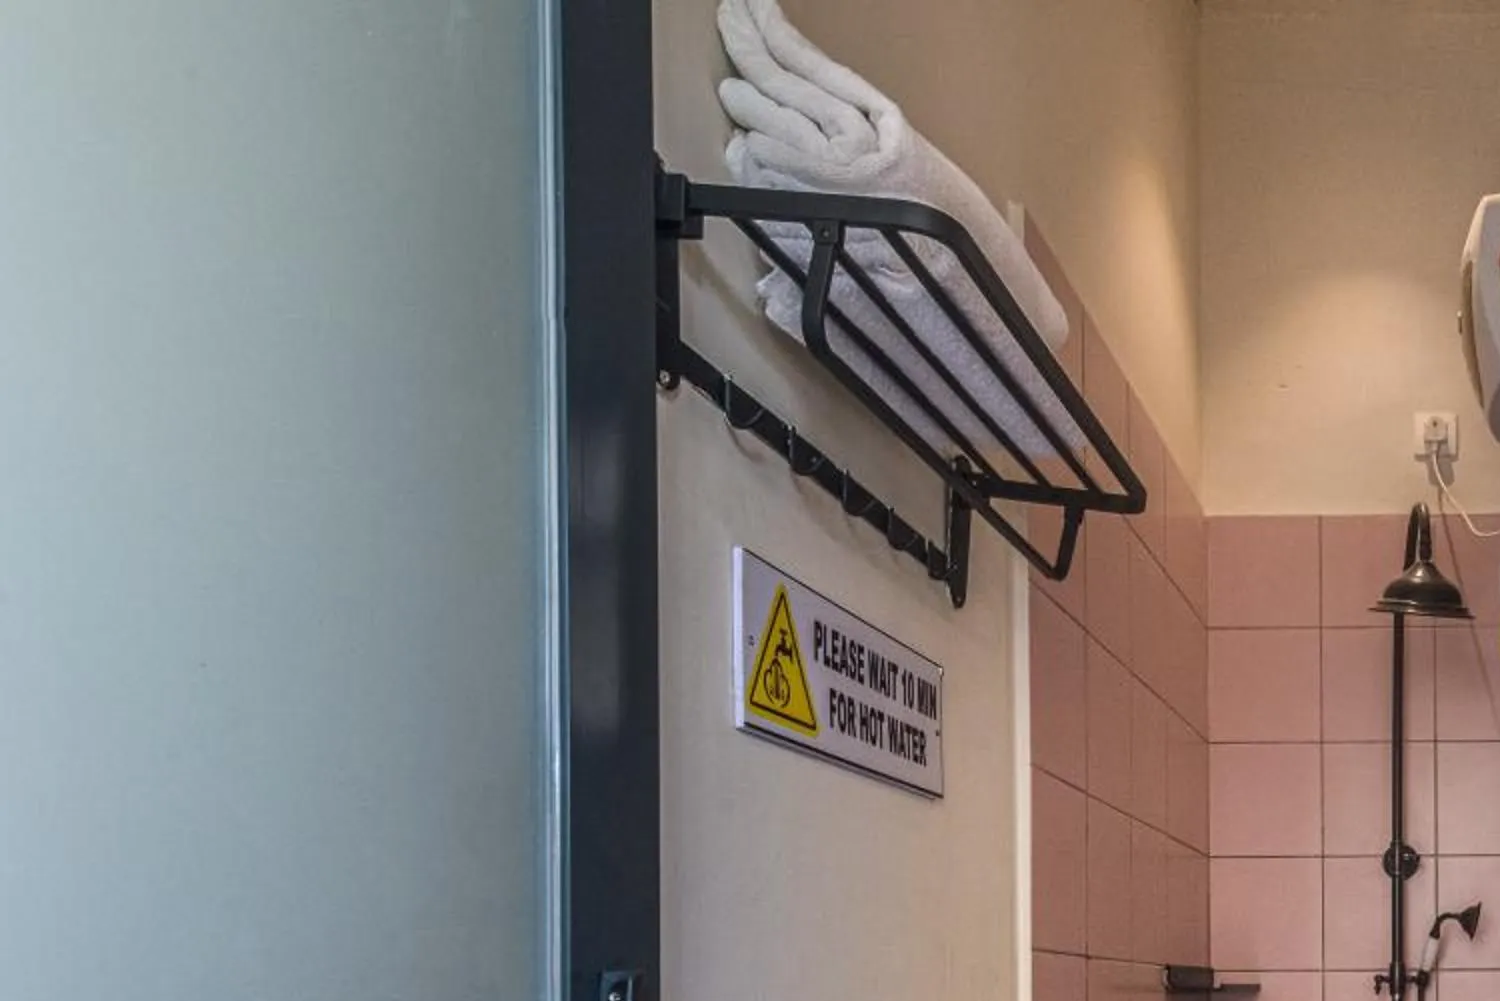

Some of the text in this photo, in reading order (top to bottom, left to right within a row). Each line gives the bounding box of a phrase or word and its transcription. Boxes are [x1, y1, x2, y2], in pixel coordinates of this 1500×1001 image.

[813, 620, 937, 720] PLEASE WAIT 10 MIN
[829, 688, 927, 767] FOR HOT WATER
